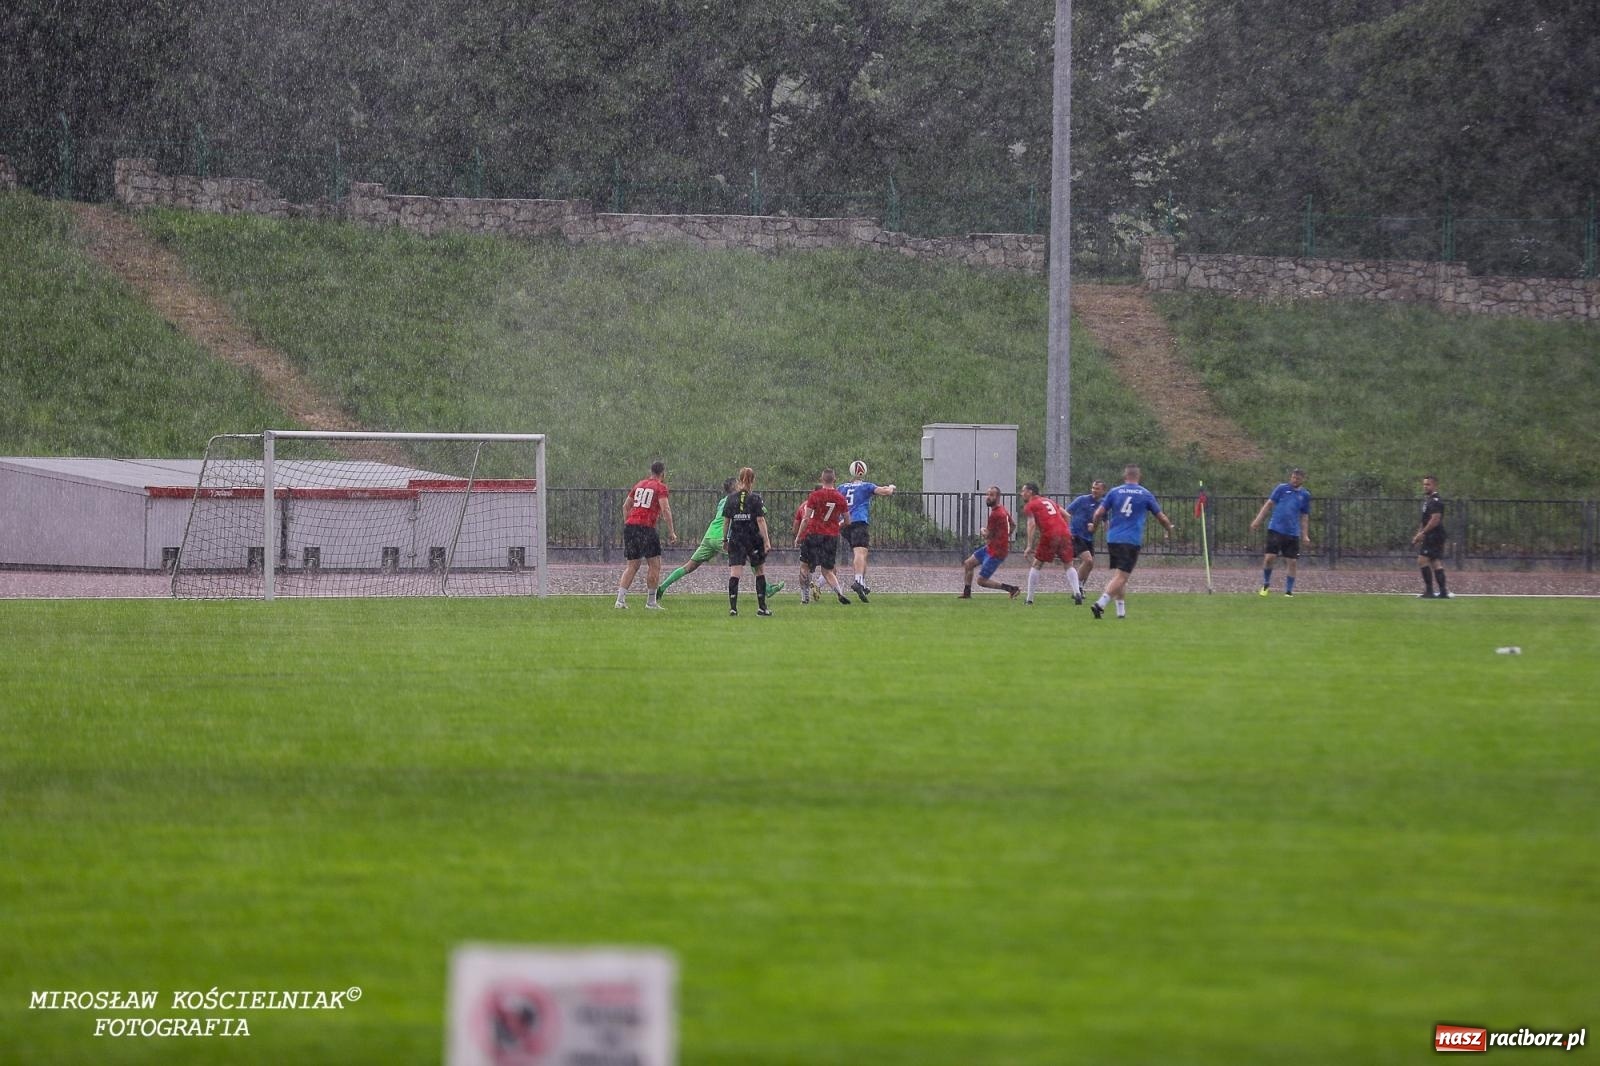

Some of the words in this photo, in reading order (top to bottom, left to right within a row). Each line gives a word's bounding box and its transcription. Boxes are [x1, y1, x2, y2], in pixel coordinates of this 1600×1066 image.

[633, 488, 655, 509] 90
[846, 489, 855, 506] 5
[1120, 496, 1133, 517] 4
[823, 502, 836, 521] 7
[1041, 501, 1057, 515] 3
